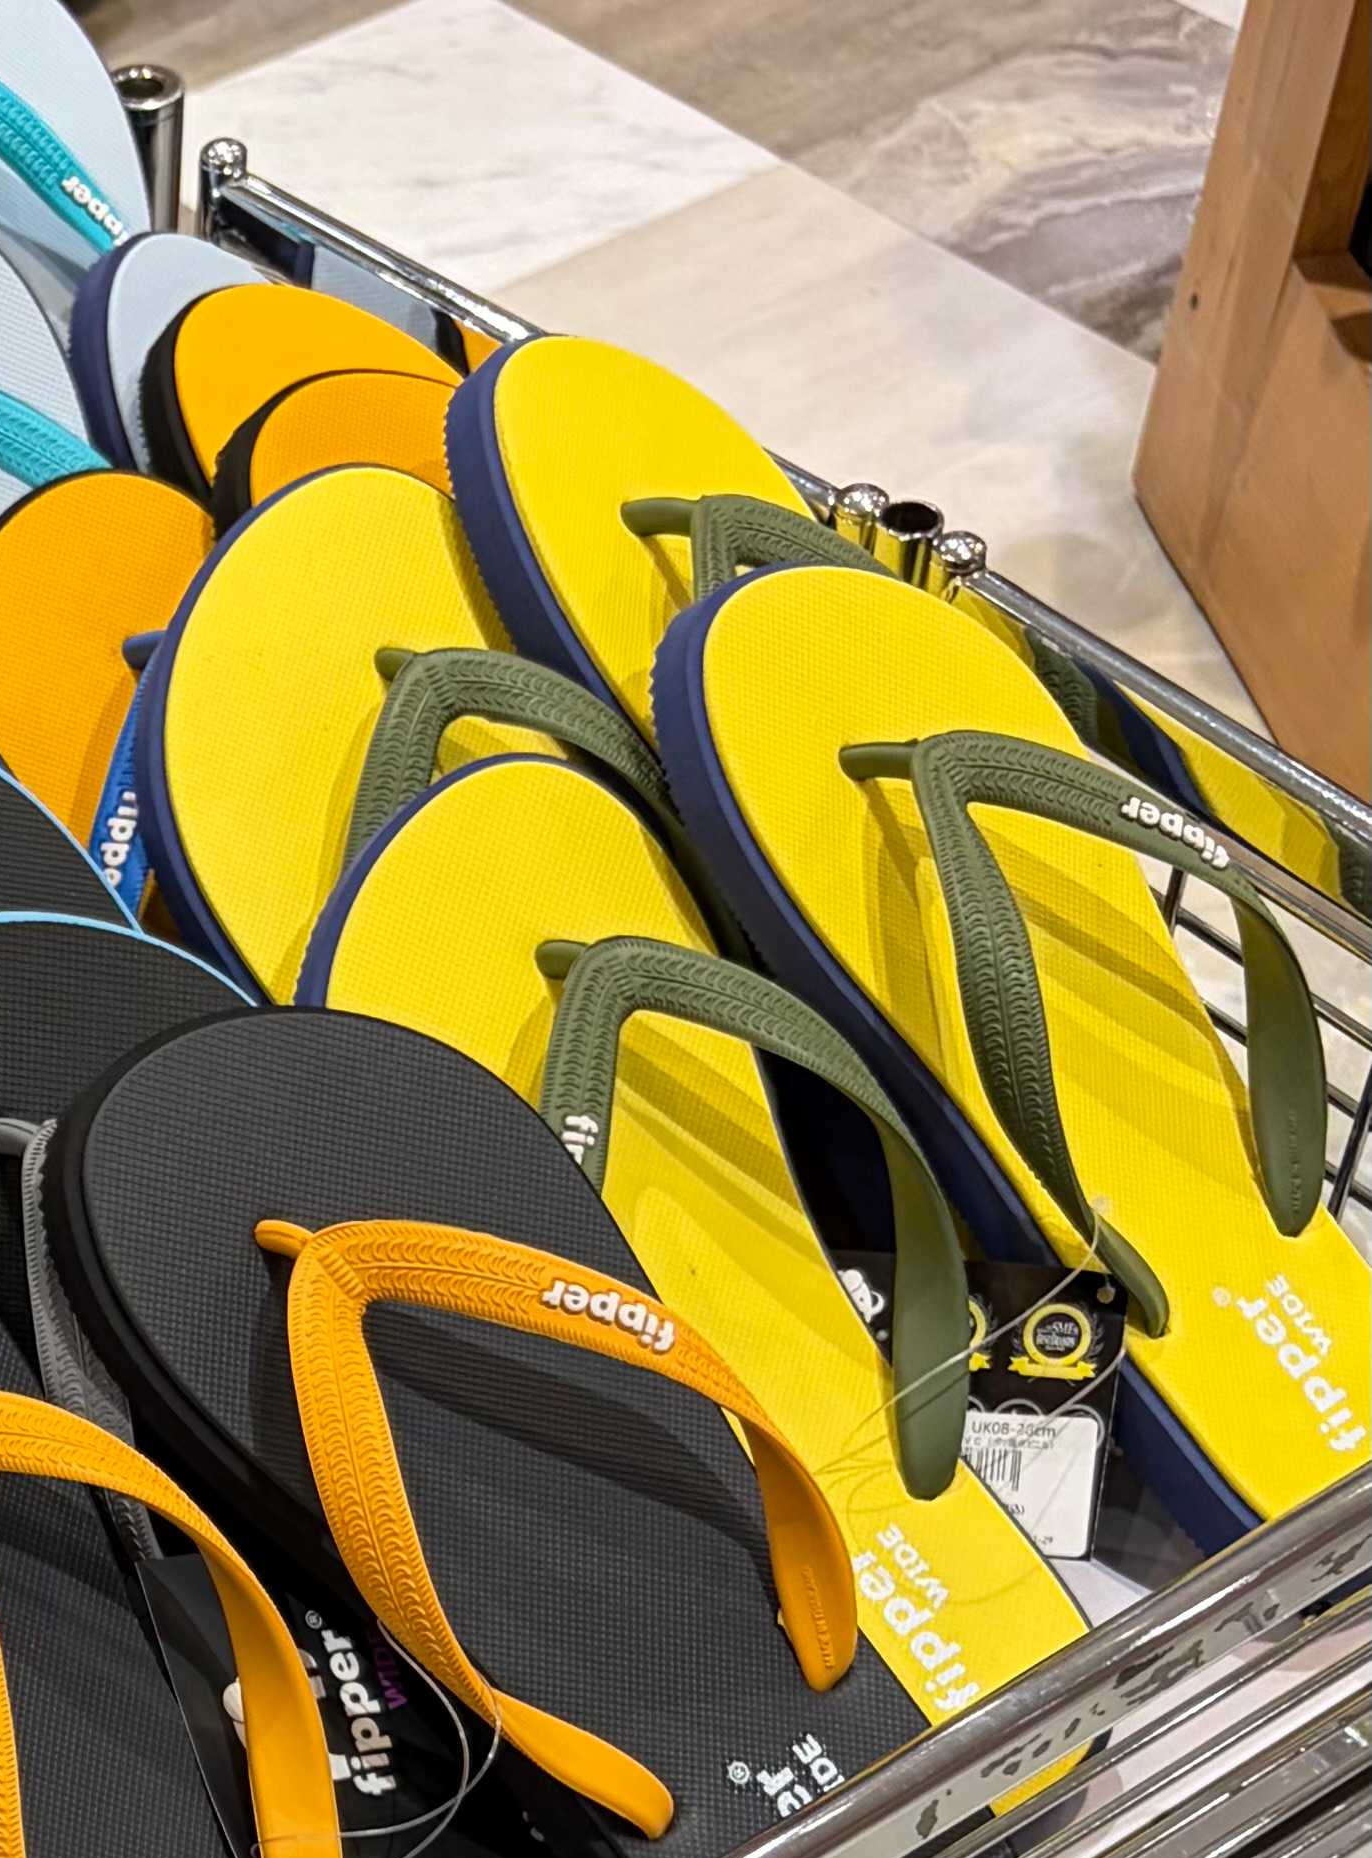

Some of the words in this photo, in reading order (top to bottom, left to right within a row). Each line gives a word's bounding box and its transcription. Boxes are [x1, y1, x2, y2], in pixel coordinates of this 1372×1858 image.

[61, 176, 128, 247] ipper
[1121, 797, 1230, 869] fipper
[542, 1280, 675, 1352] fipper
[1266, 1274, 1332, 1357] WIDE
[1236, 1297, 1367, 1452] fipper
[876, 1524, 950, 1610] WIDE
[321, 1629, 396, 1796] fipper
[792, 1733, 845, 1792] IDE
